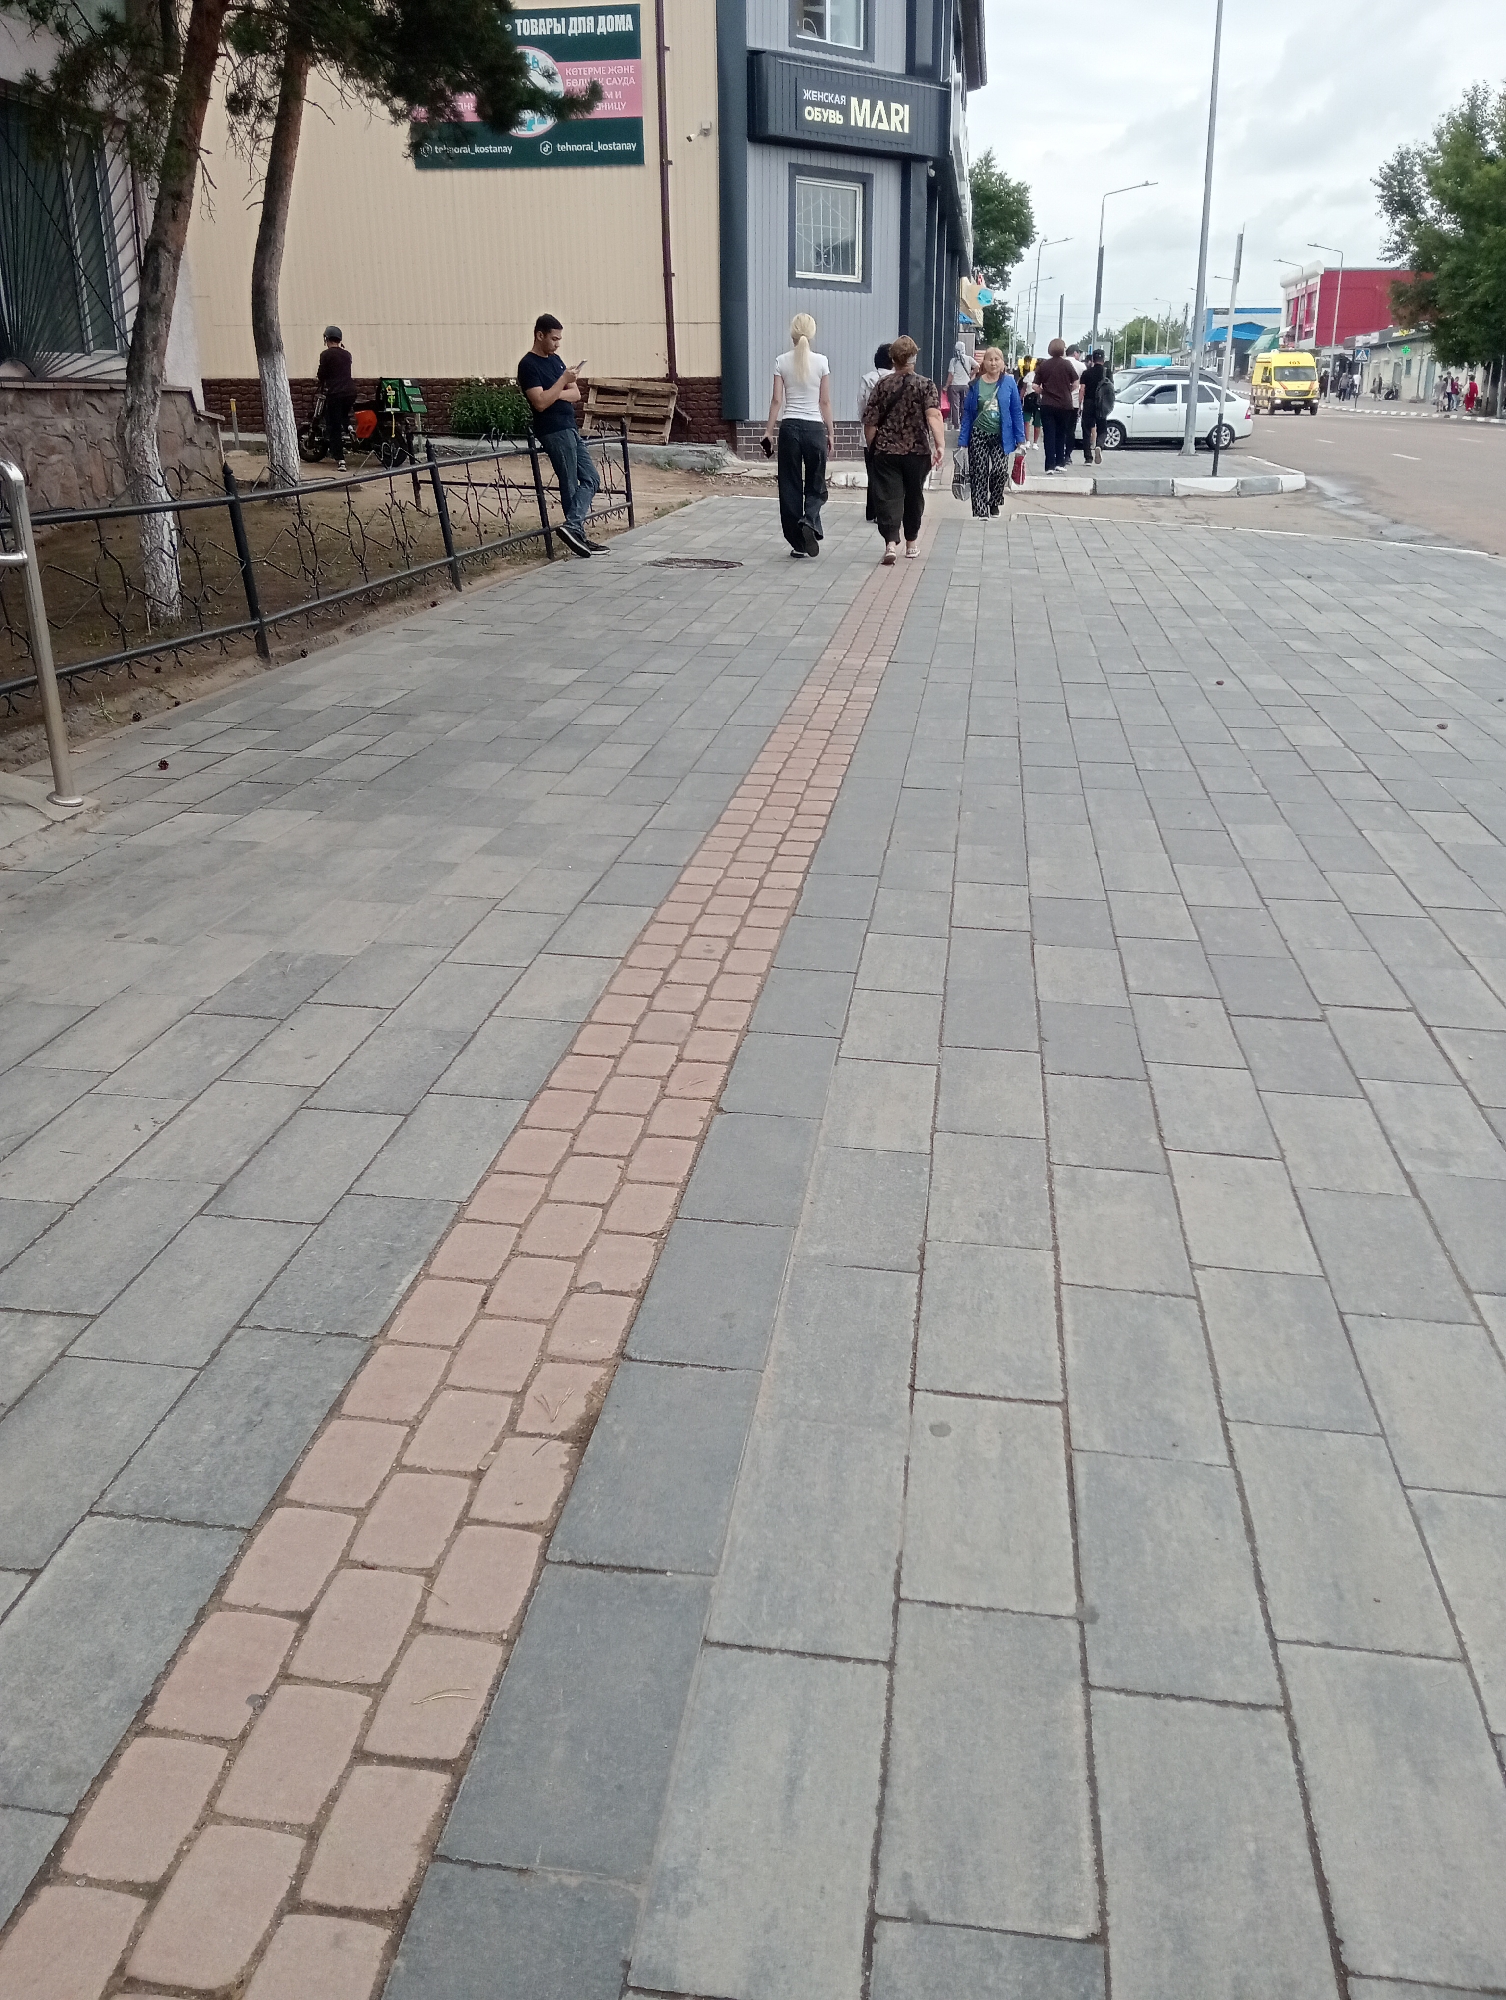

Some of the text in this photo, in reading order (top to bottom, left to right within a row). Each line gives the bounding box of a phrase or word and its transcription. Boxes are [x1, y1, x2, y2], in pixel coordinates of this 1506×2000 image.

[514, 14, 634, 37] ТОВАРЫ ДЛЯ ДОМА
[606, 77, 636, 87] САУДА
[803, 89, 846, 105] ЖЕНСКАЯ
[804, 106, 844, 124] ОБУВЬ
[850, 96, 910, 133] MARI
[557, 141, 637, 153] tehnorai_kostanay
